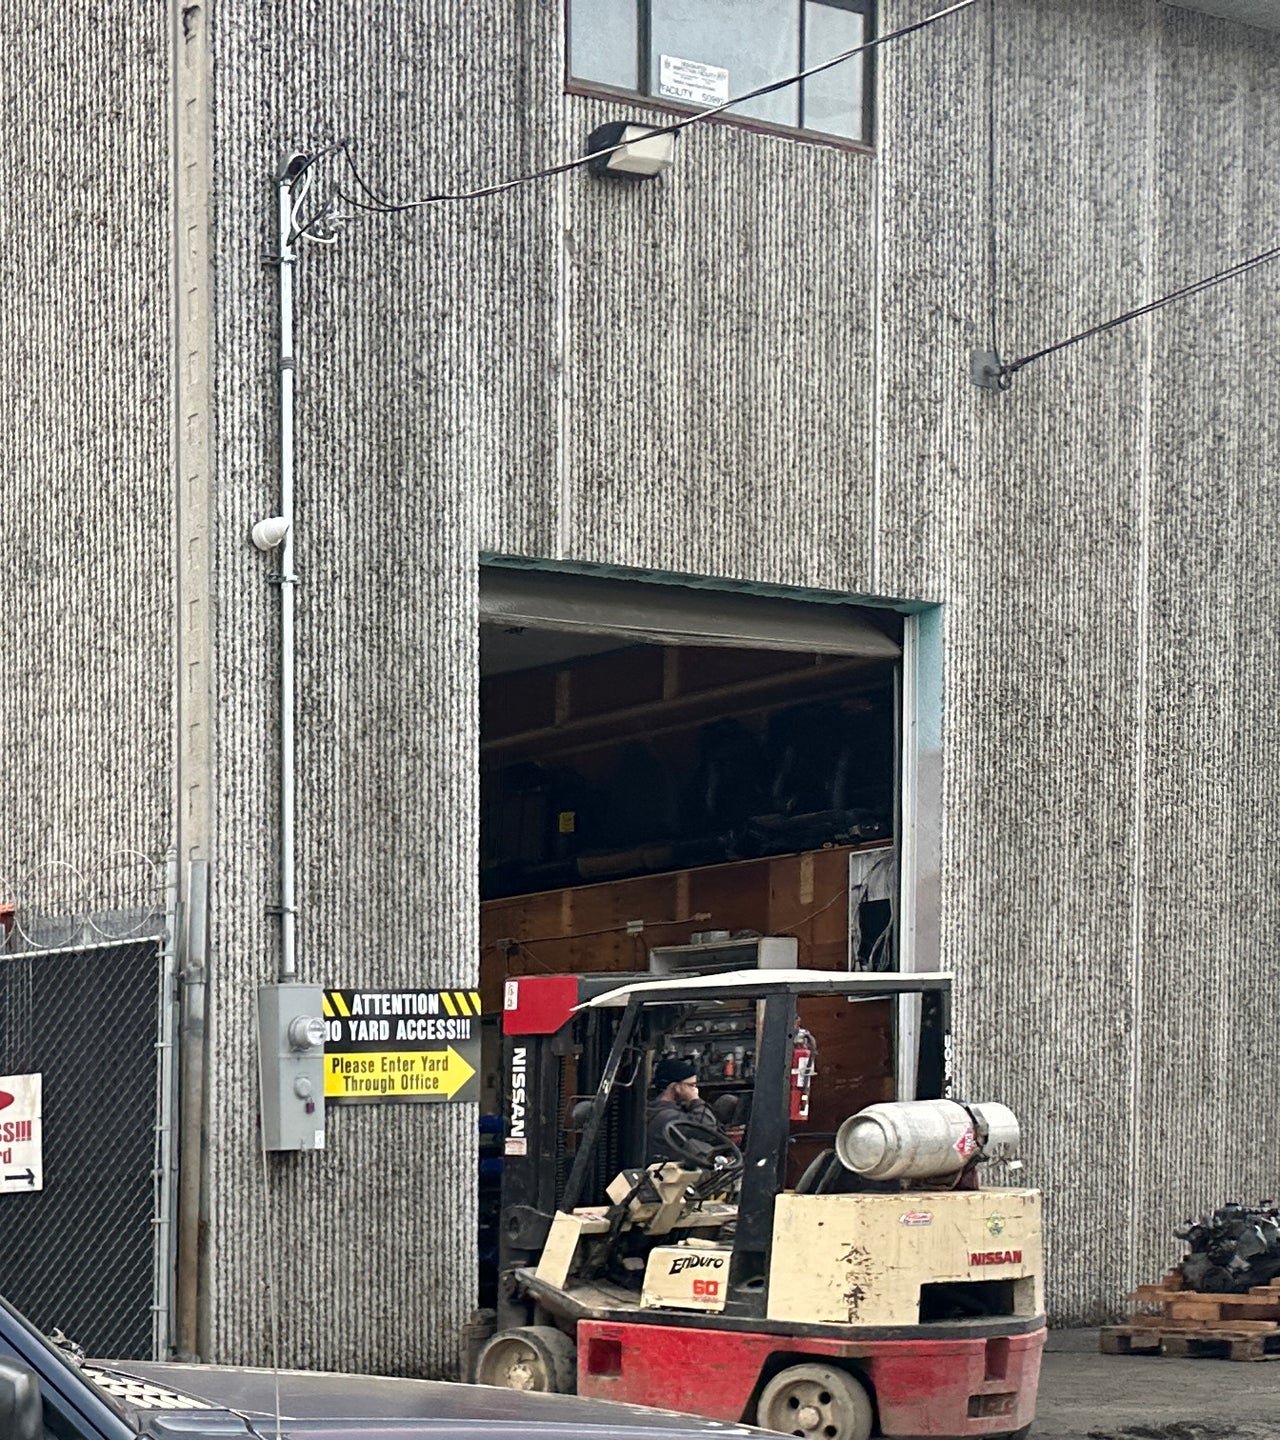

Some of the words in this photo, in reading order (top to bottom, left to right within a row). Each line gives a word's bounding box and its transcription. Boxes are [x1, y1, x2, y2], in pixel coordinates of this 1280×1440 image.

[352, 994, 439, 1015] ATTENTION
[348, 1020, 389, 1041] YARD
[396, 1018, 471, 1041] ACCESS!!!
[332, 1057, 375, 1074] Please
[381, 1056, 416, 1072] Enter
[420, 1055, 449, 1072] Yard
[343, 1075, 395, 1093] Through
[401, 1074, 439, 1091] Office
[510, 1047, 527, 1137] NISSAN
[970, 1250, 1022, 1266] NISSAN
[693, 1279, 719, 1295] 60
